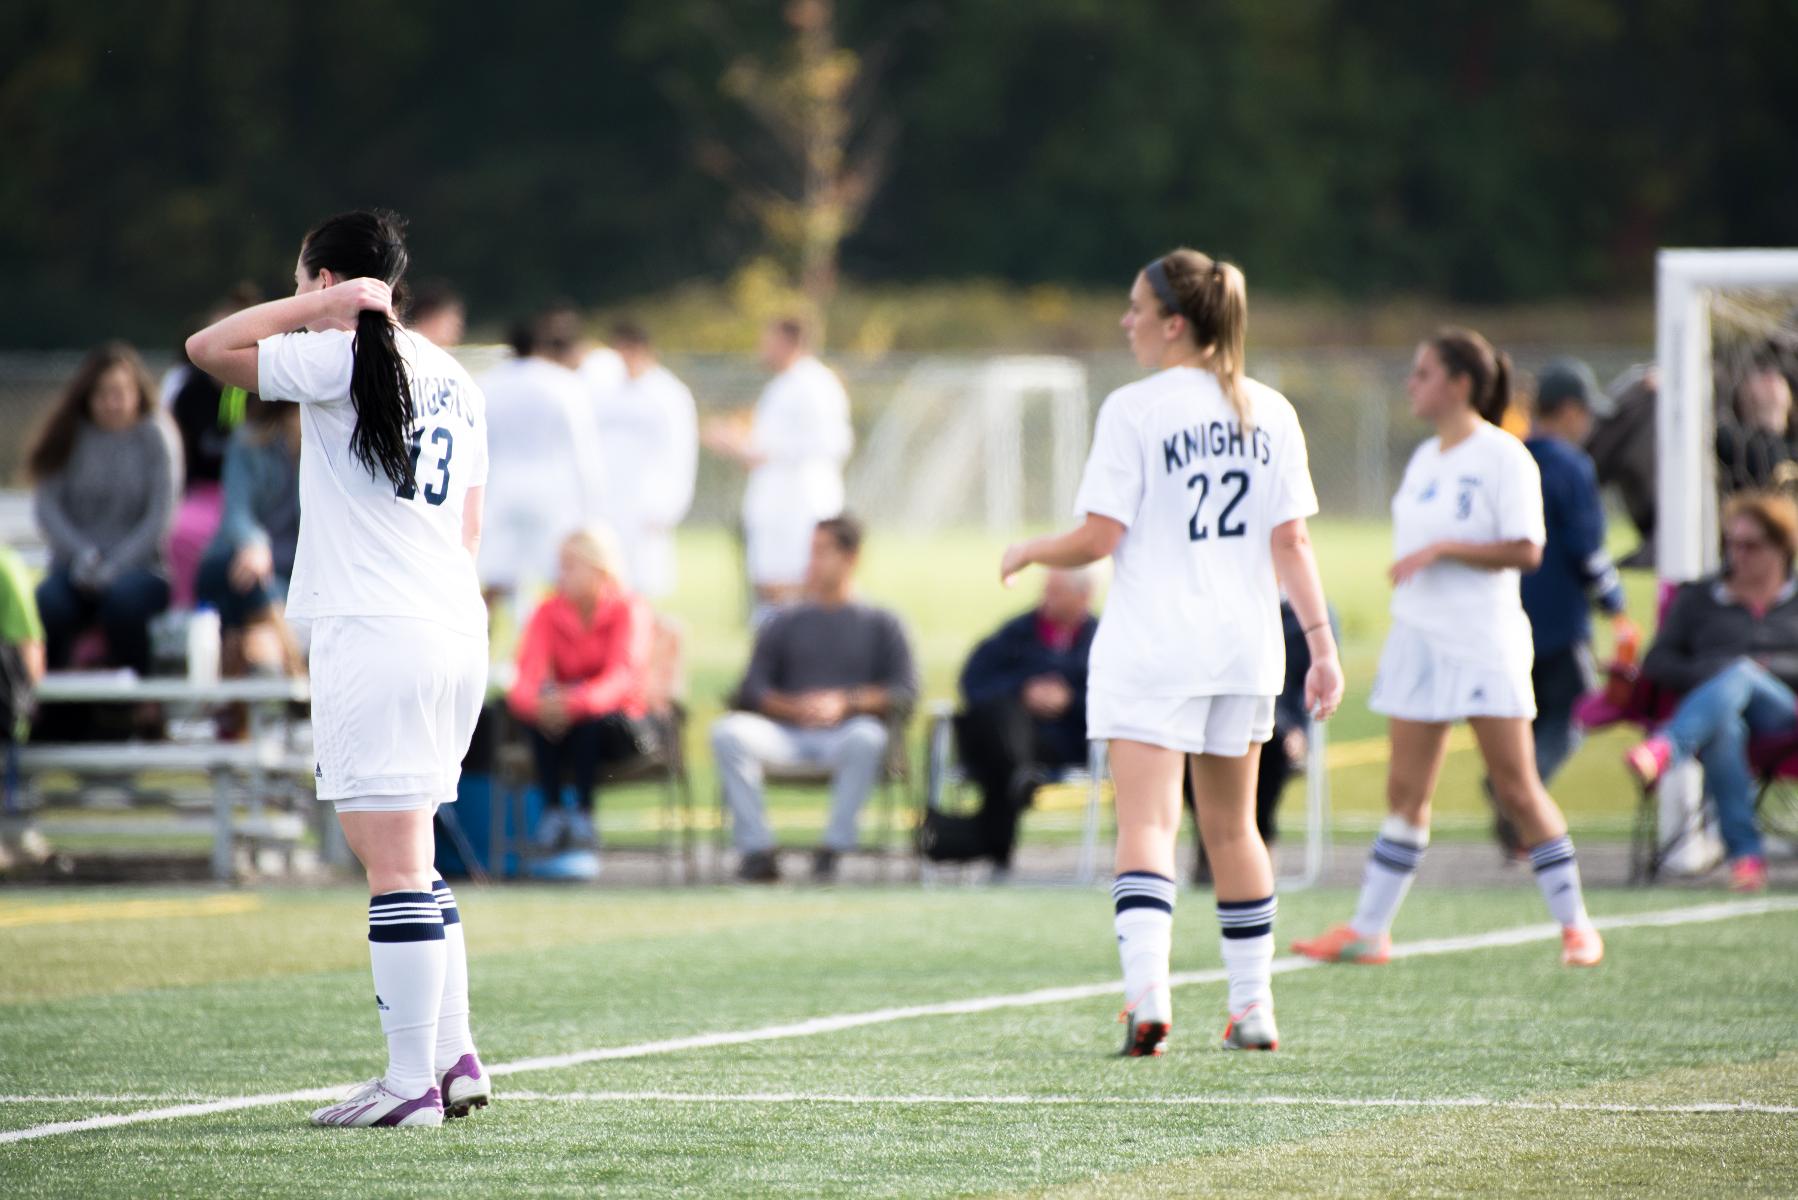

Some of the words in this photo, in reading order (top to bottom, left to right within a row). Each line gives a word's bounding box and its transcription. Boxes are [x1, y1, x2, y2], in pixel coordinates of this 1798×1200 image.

[410, 376, 475, 427] IGHTS
[1163, 420, 1271, 475] KNIGHTS
[1187, 469, 1251, 542] 22
